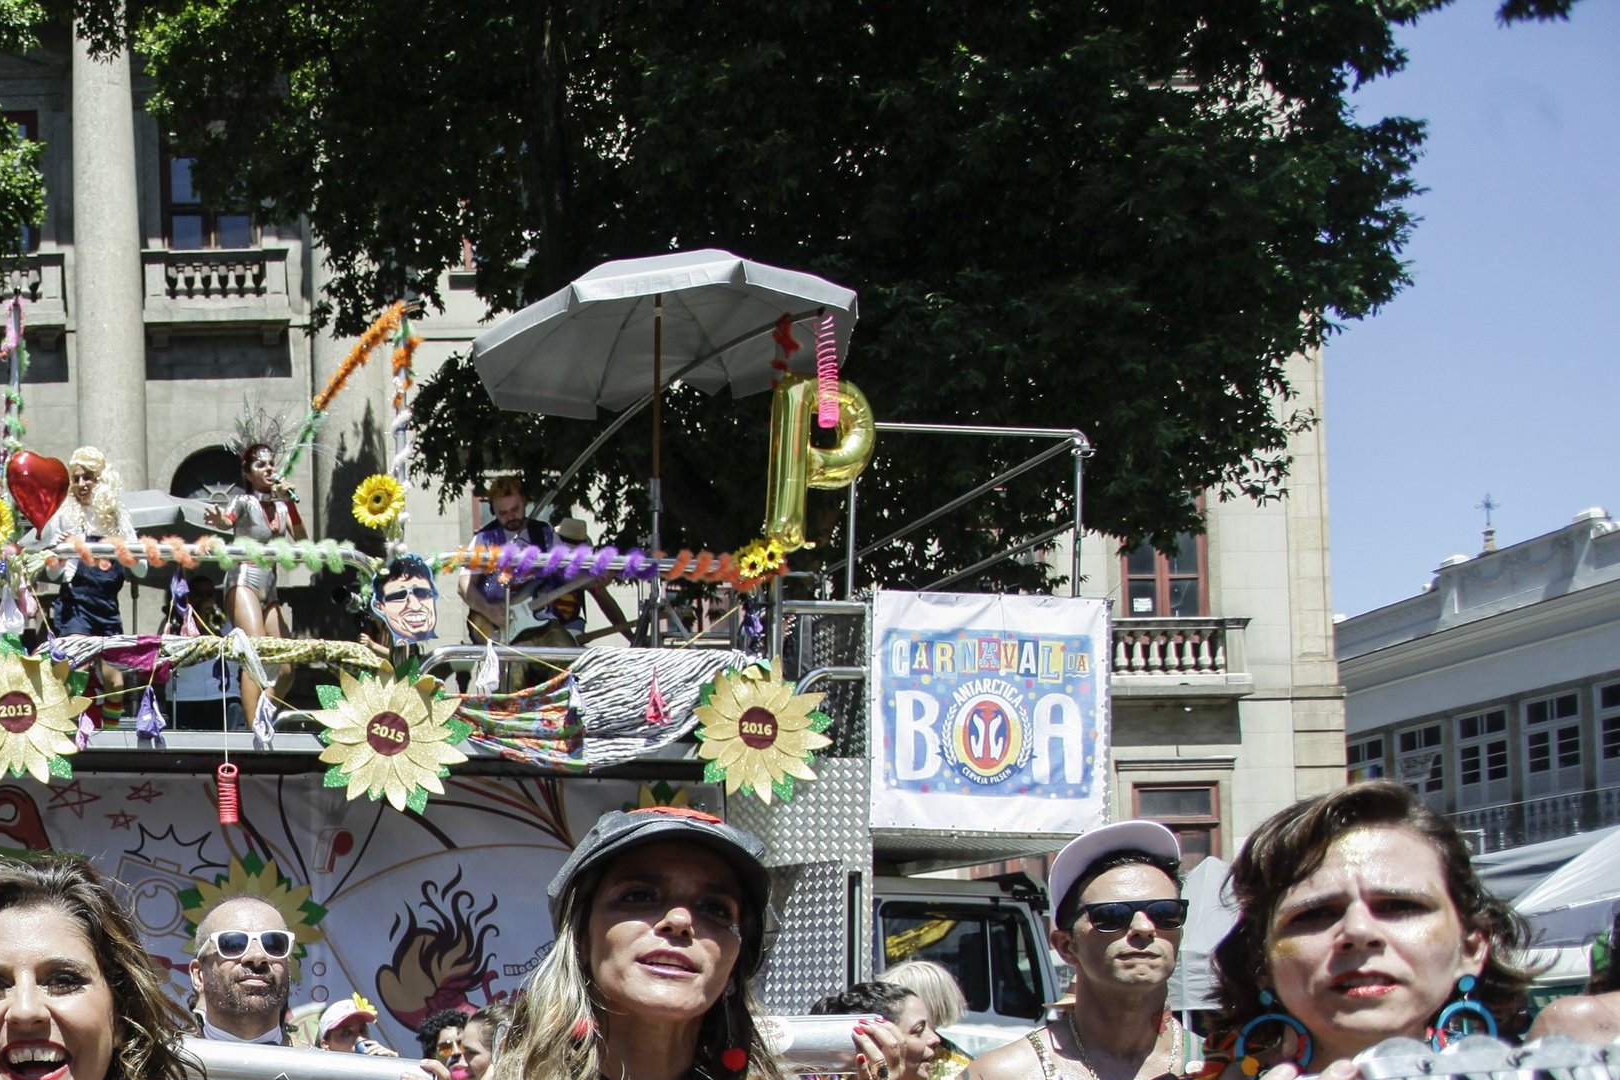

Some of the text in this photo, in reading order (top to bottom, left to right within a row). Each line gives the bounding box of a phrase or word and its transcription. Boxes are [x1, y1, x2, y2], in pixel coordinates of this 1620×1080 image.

[766, 372, 876, 553] P
[891, 639, 1087, 680] CARNAVAL DA
[952, 678, 1026, 706] ANTARCTICA
[370, 722, 406, 743] 2015
[741, 721, 773, 736] 2016
[989, 767, 1013, 784] PILSEN
